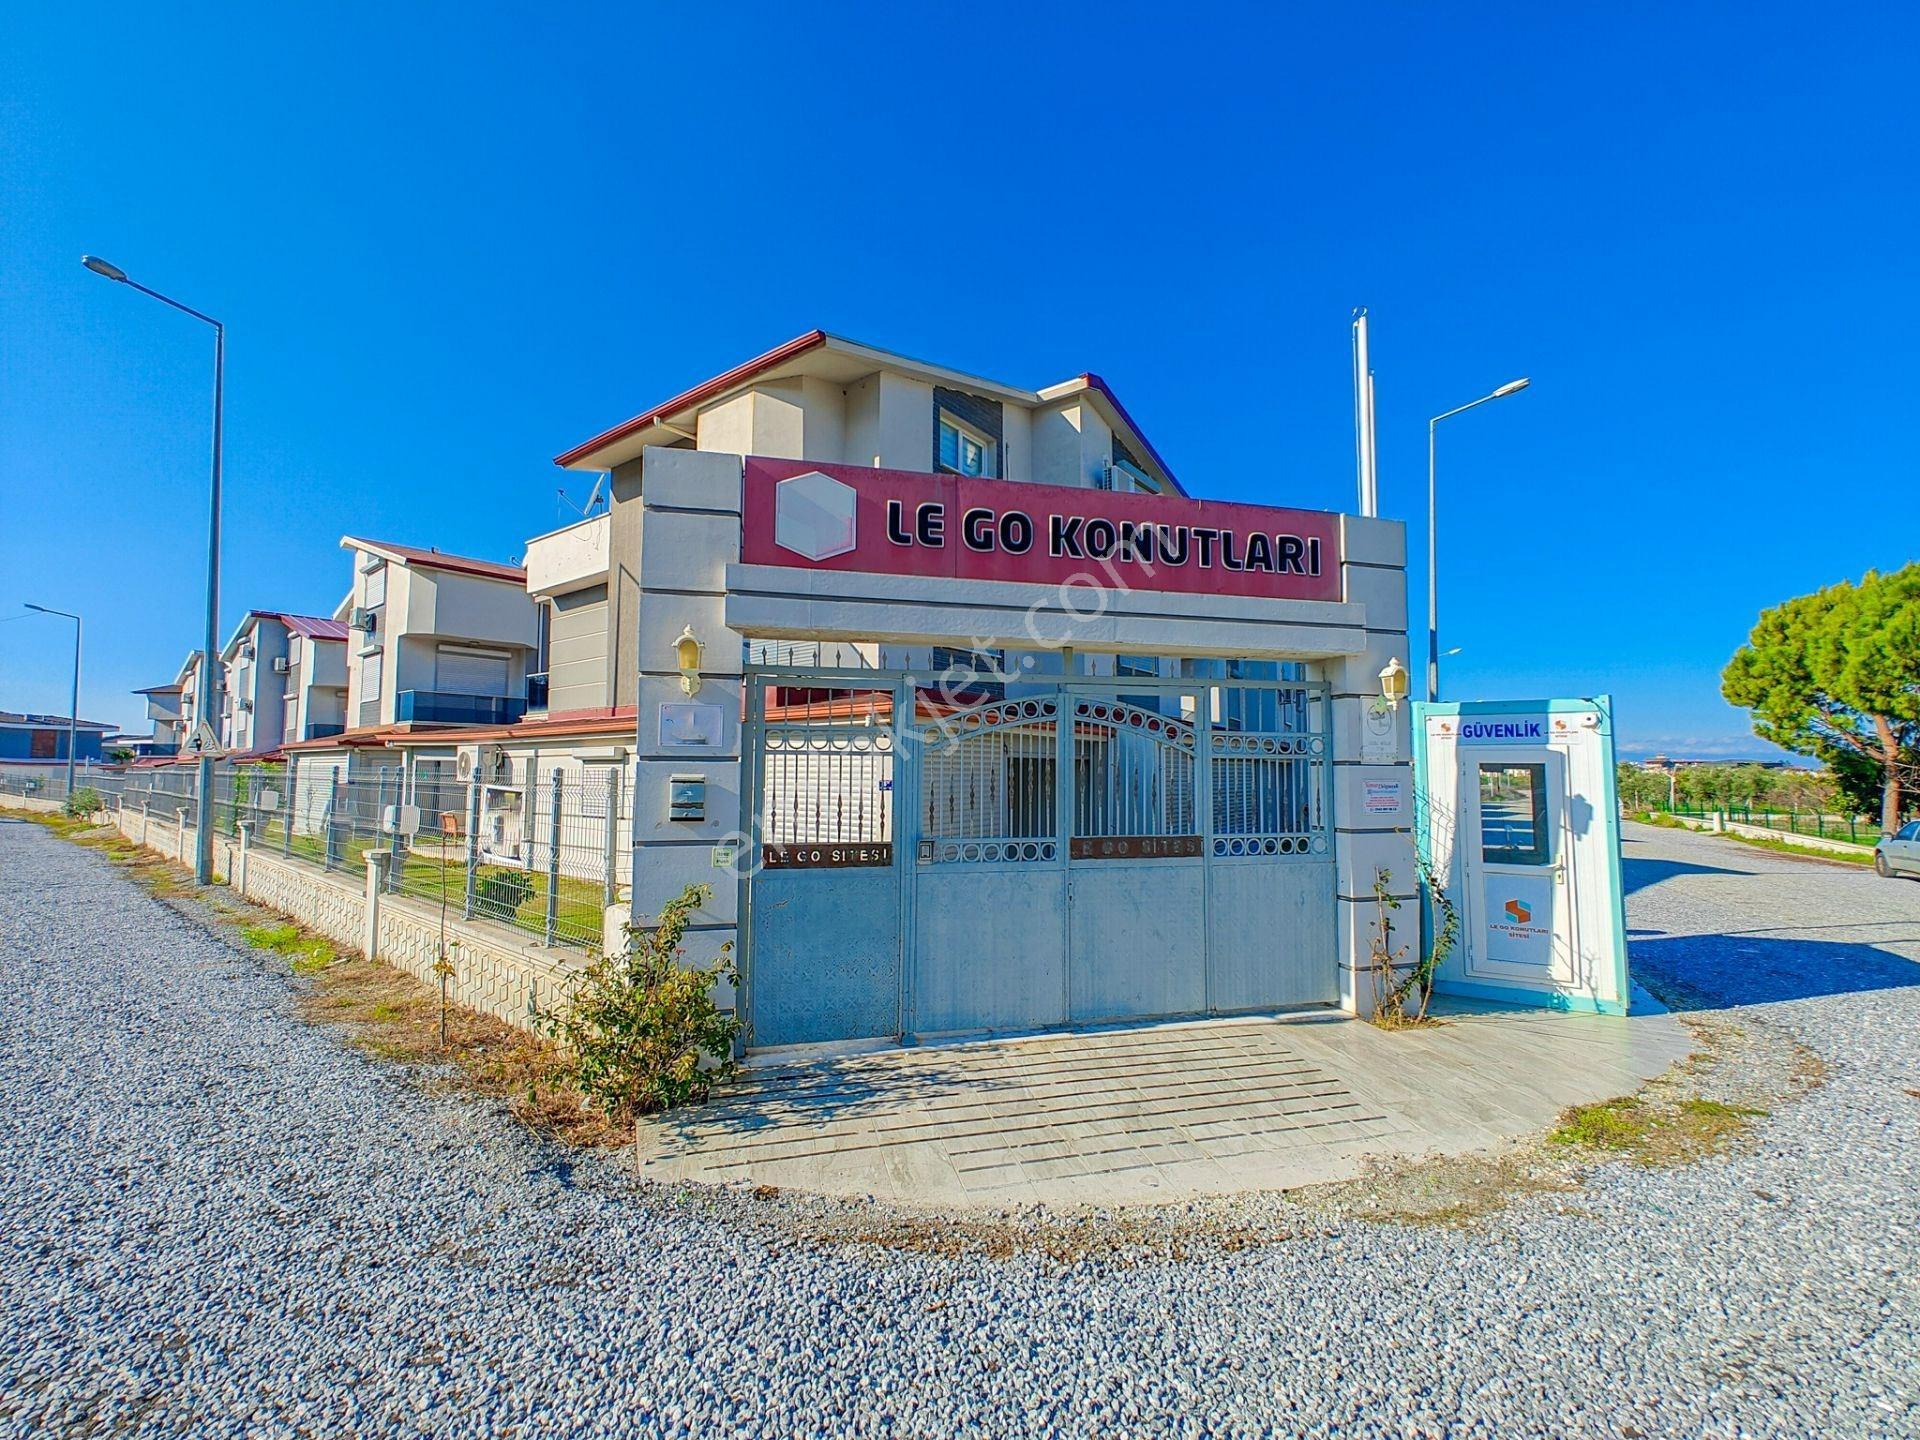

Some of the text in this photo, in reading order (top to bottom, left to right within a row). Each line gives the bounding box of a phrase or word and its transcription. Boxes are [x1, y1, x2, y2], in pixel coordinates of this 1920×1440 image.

[887, 500, 1321, 577] LE GO KONUTLARI
[1463, 720, 1541, 738] GÜVENLİK
